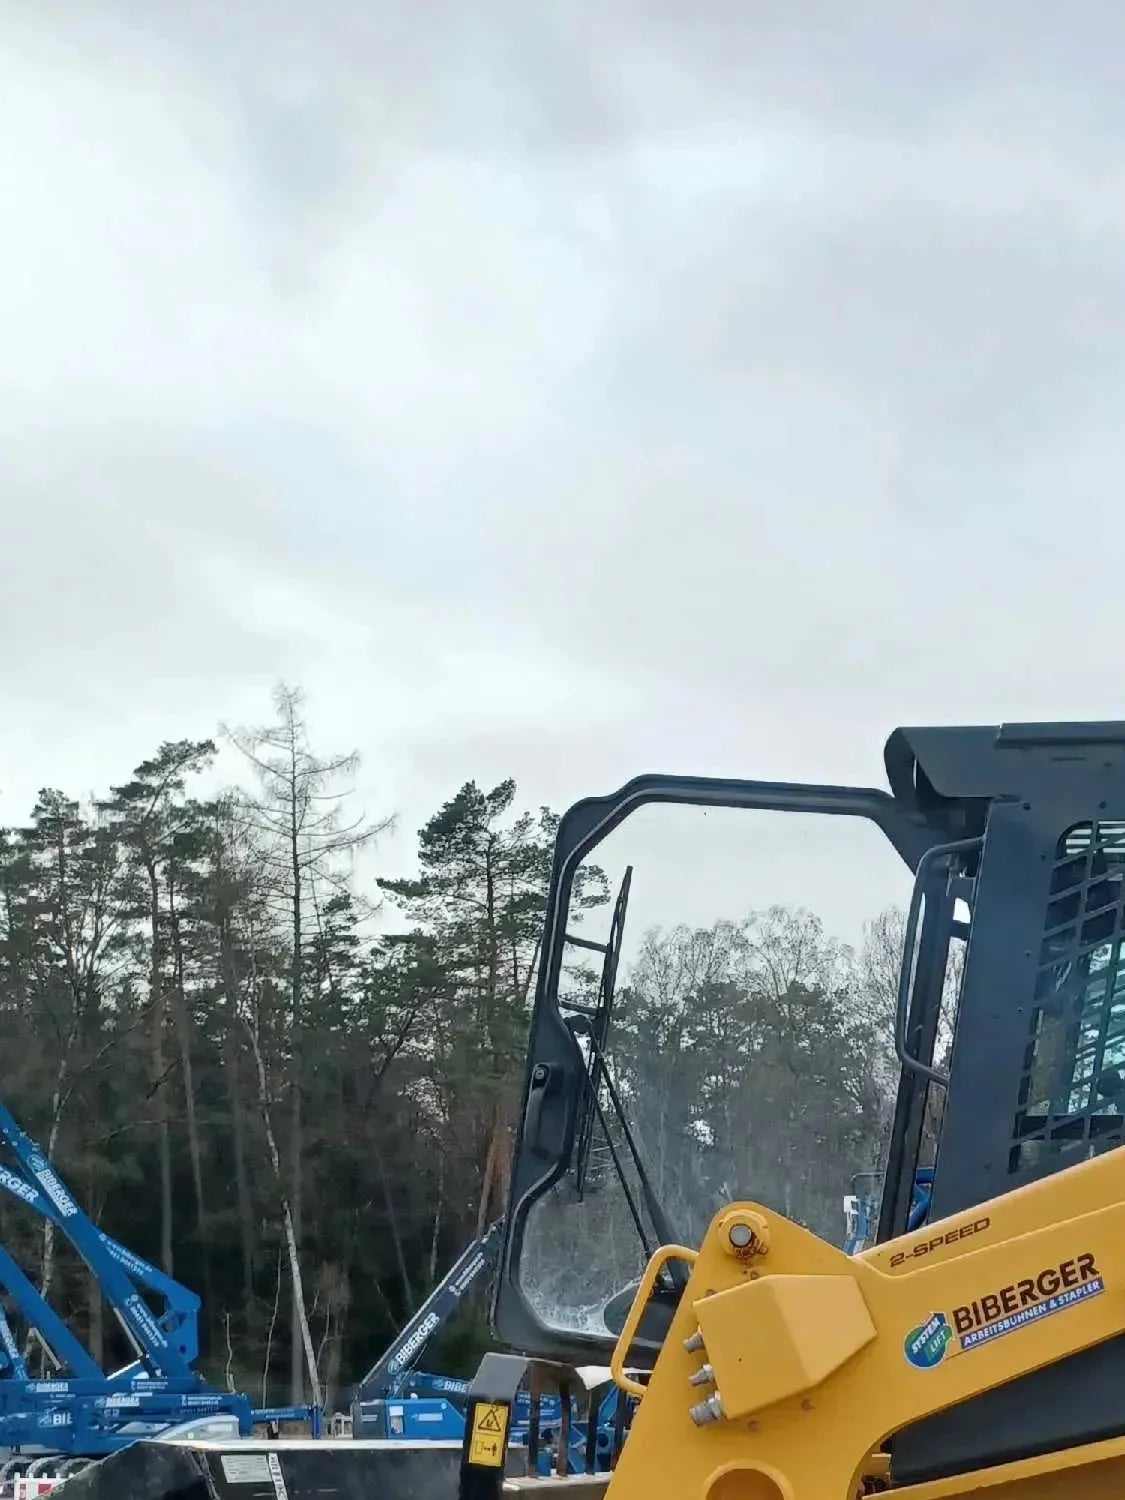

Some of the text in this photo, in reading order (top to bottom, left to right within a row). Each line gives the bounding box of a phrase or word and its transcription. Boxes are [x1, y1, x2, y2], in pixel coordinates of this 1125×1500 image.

[889, 1217, 991, 1268] 2-SPEED
[953, 1252, 1100, 1334] BIBERGER
[1058, 1280, 1101, 1305] STAPLER
[395, 1312, 440, 1365] BIBERGER
